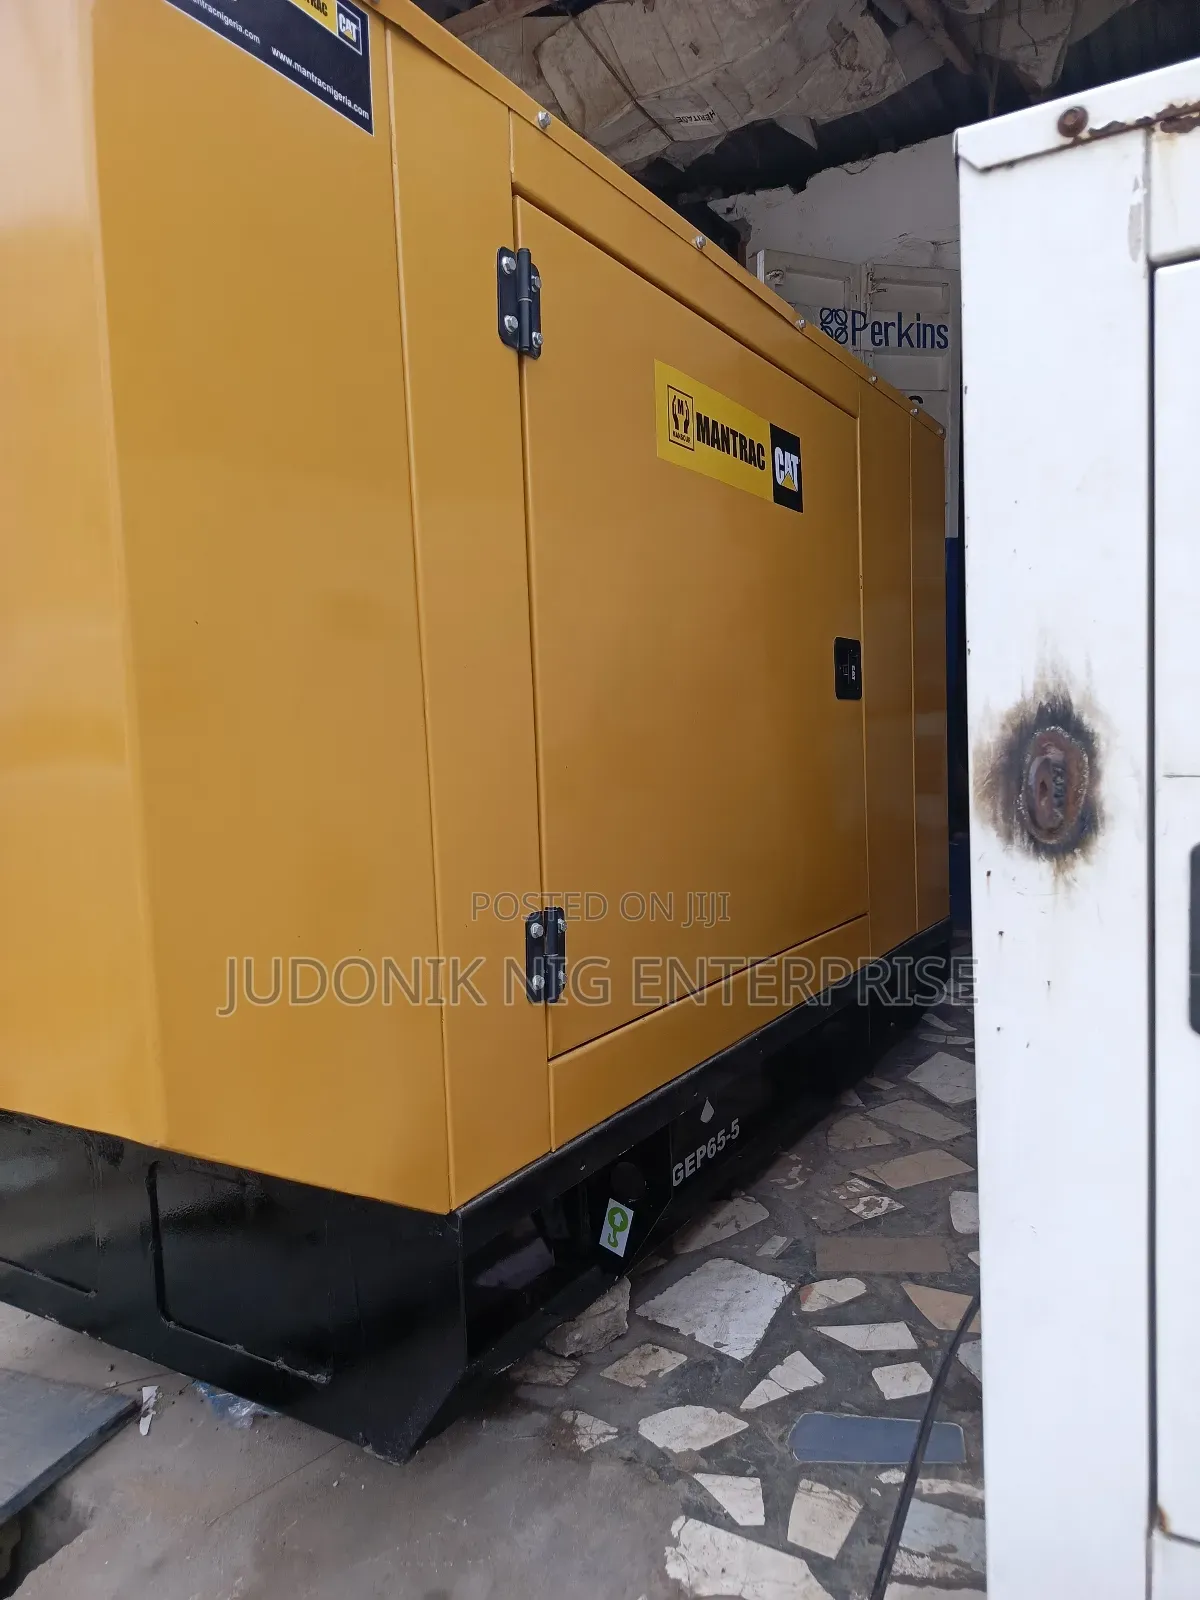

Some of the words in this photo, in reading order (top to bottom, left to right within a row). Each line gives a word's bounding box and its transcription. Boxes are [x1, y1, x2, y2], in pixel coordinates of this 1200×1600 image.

[338, 13, 357, 43] CAT
[271, 46, 370, 120] www.mantracnigeria.com
[851, 310, 949, 350] Perkins
[695, 411, 766, 471] MANTRAC
[774, 446, 800, 492] CAT
[672, 1118, 740, 1187] GEP65-5
